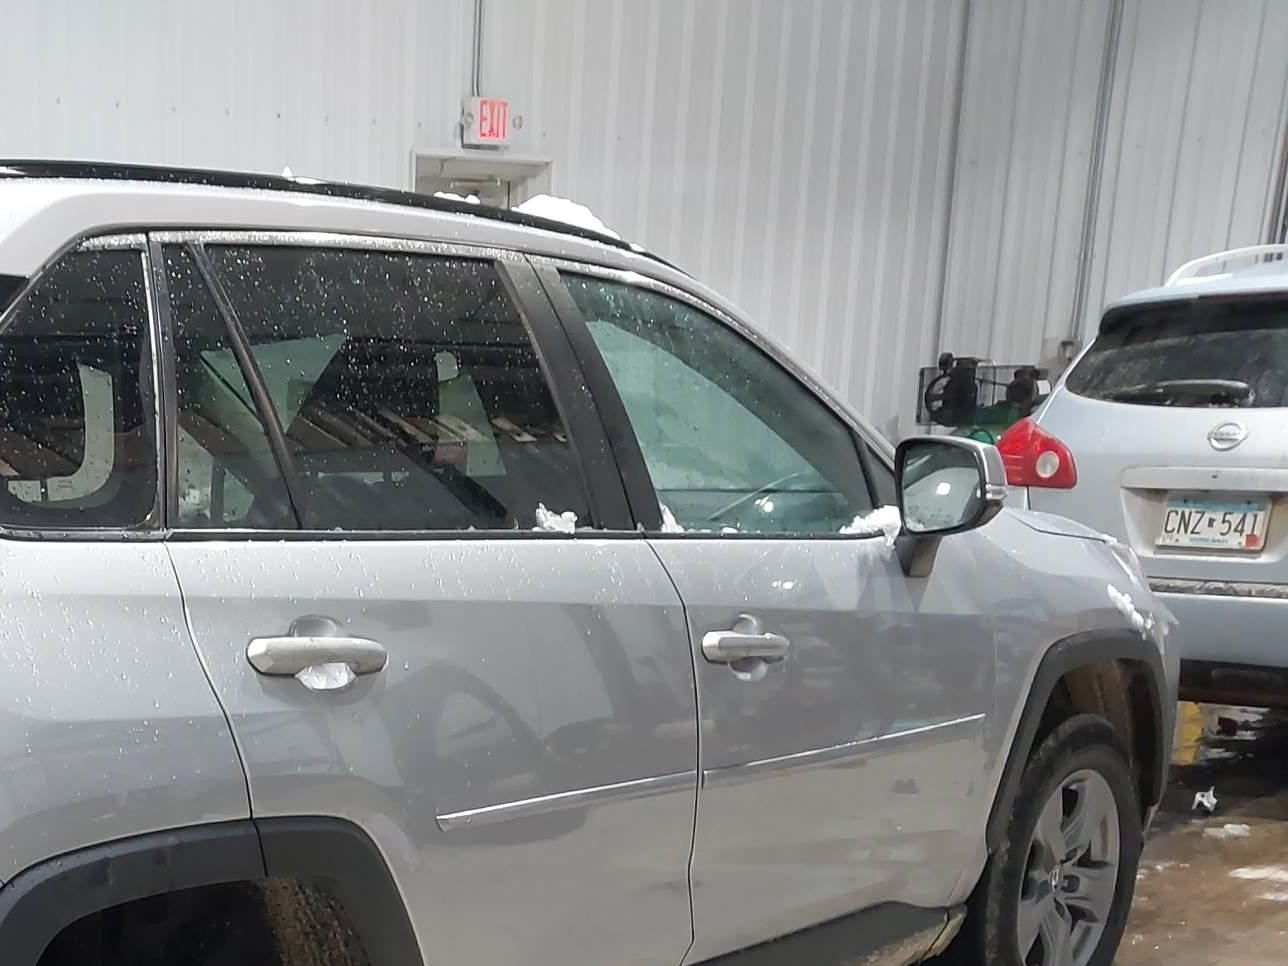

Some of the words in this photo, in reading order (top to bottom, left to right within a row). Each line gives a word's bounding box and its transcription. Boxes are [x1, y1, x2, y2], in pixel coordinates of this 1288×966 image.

[479, 99, 509, 138] EXIT
[1164, 509, 1206, 535] CNZ
[1219, 511, 1259, 537] 541
